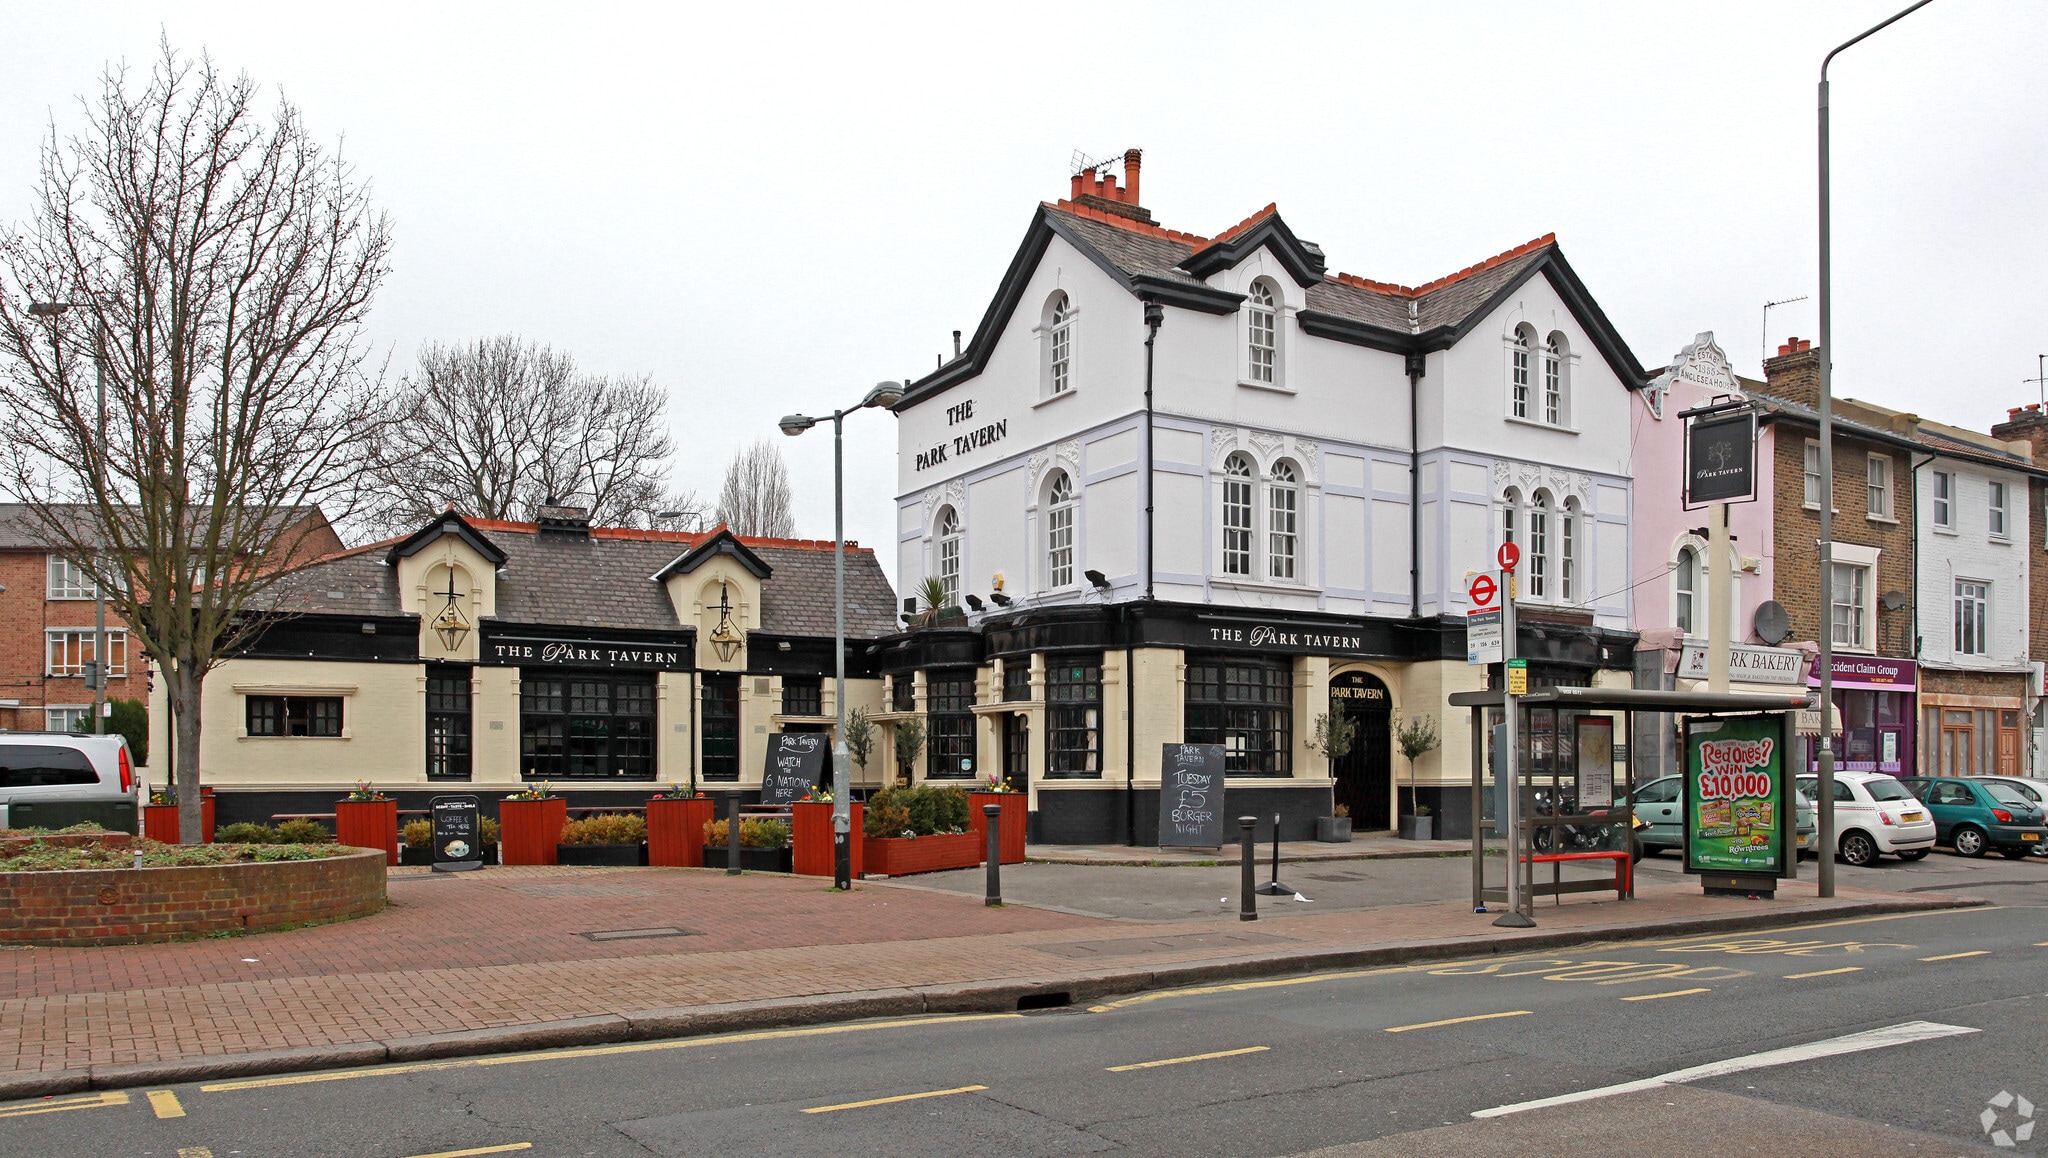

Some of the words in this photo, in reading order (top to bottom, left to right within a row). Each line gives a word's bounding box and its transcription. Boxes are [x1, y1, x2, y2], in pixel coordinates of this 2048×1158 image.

[1714, 379, 1733, 390] HOUSE
[946, 399, 973, 426] THE
[916, 444, 948, 471] PARK
[954, 418, 1007, 456] TAVERN
[1697, 469, 1717, 479] PARK
[1718, 467, 1743, 476] TAVERN
[1503, 546, 1513, 564] L
[1211, 628, 1242, 642] THE
[1250, 625, 1298, 646] PARK
[1304, 634, 1360, 649] TAVERN
[495, 645, 533, 658] THE
[542, 643, 600, 662] PARK
[608, 650, 677, 663] TAVERN
[1730, 652, 1748, 667] RK
[1751, 654, 1799, 671] BAKERY
[1831, 662, 1855, 672] ccident
[1856, 663, 1876, 674] Claim
[1877, 665, 1898, 678] Group
[1331, 687, 1351, 698] PARK
[1352, 687, 1383, 699] TAVERN
[781, 735, 797, 746] PARK
[798, 735, 818, 747] TAVERN
[1180, 744, 1200, 754] PARK
[1702, 742, 1730, 769] Red
[1733, 740, 1771, 764] Ones?
[777, 756, 801, 768] WATCH
[1175, 754, 1204, 764] TAVERN
[766, 774, 773, 787] 6
[777, 775, 810, 789] NATIONS
[1173, 769, 1211, 785] TUESDAY
[776, 788, 793, 798] HERE
[1701, 774, 1768, 799] £10,000
[1178, 790, 1208, 809] £5
[1171, 809, 1212, 824] BURGER
[1176, 823, 1205, 835] NIGHT
